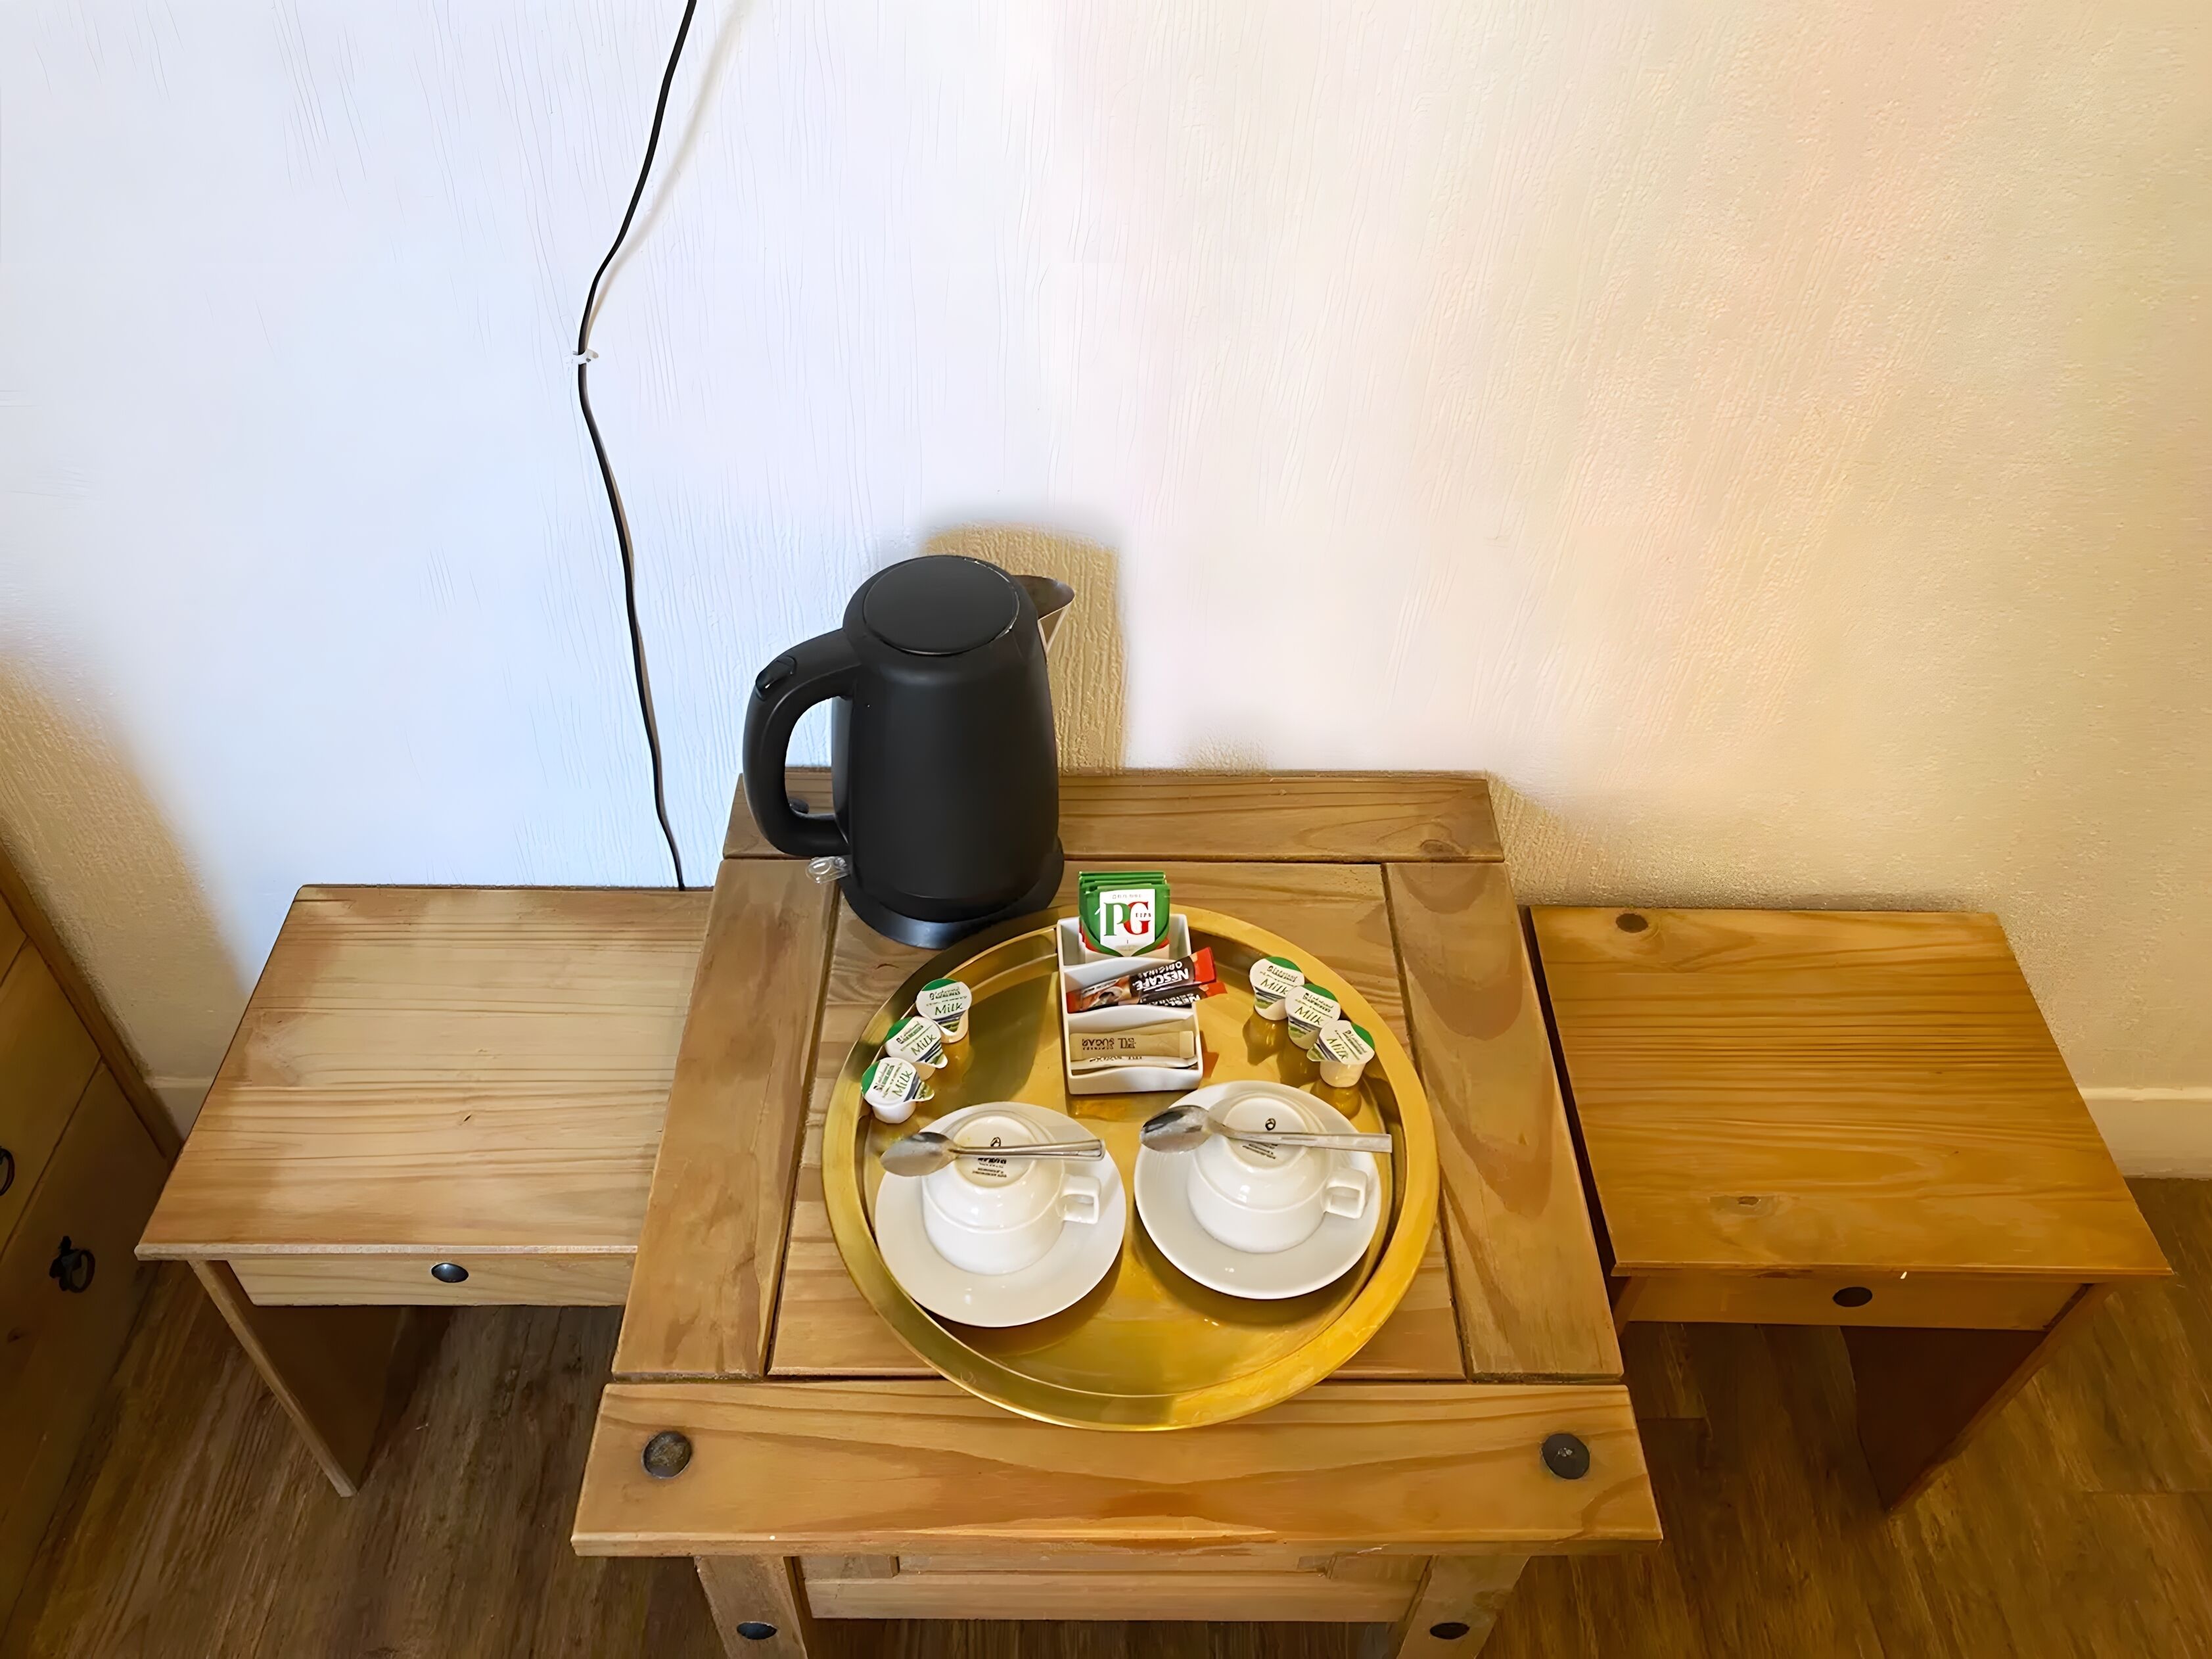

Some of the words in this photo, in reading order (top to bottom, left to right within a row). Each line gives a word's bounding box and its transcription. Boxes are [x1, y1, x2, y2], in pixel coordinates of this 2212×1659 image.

[1103, 901, 1150, 936] PG
[1260, 978, 1288, 994] Milk
[934, 1002, 963, 1015] Milk
[1295, 1006, 1324, 1025] Milk
[911, 1034, 936, 1056] Milk
[892, 1071, 913, 1097] Milk
